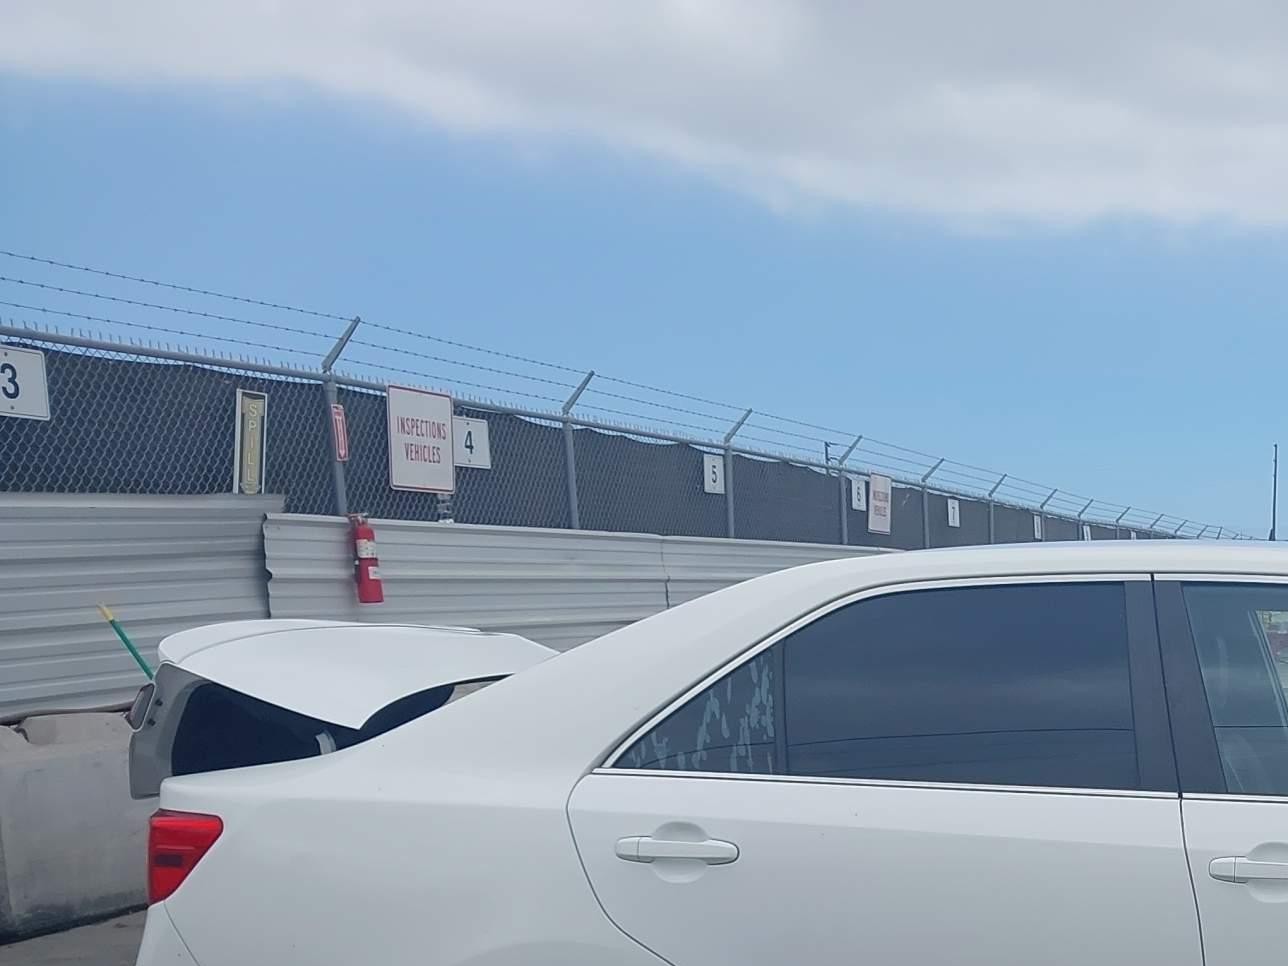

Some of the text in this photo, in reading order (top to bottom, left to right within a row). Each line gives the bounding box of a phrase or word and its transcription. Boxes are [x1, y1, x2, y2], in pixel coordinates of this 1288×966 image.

[0, 363, 20, 399] 3
[396, 416, 447, 440] INSPECTIONS
[404, 443, 441, 464] VEHICLES
[464, 430, 474, 455] 4
[711, 465, 718, 483] 5
